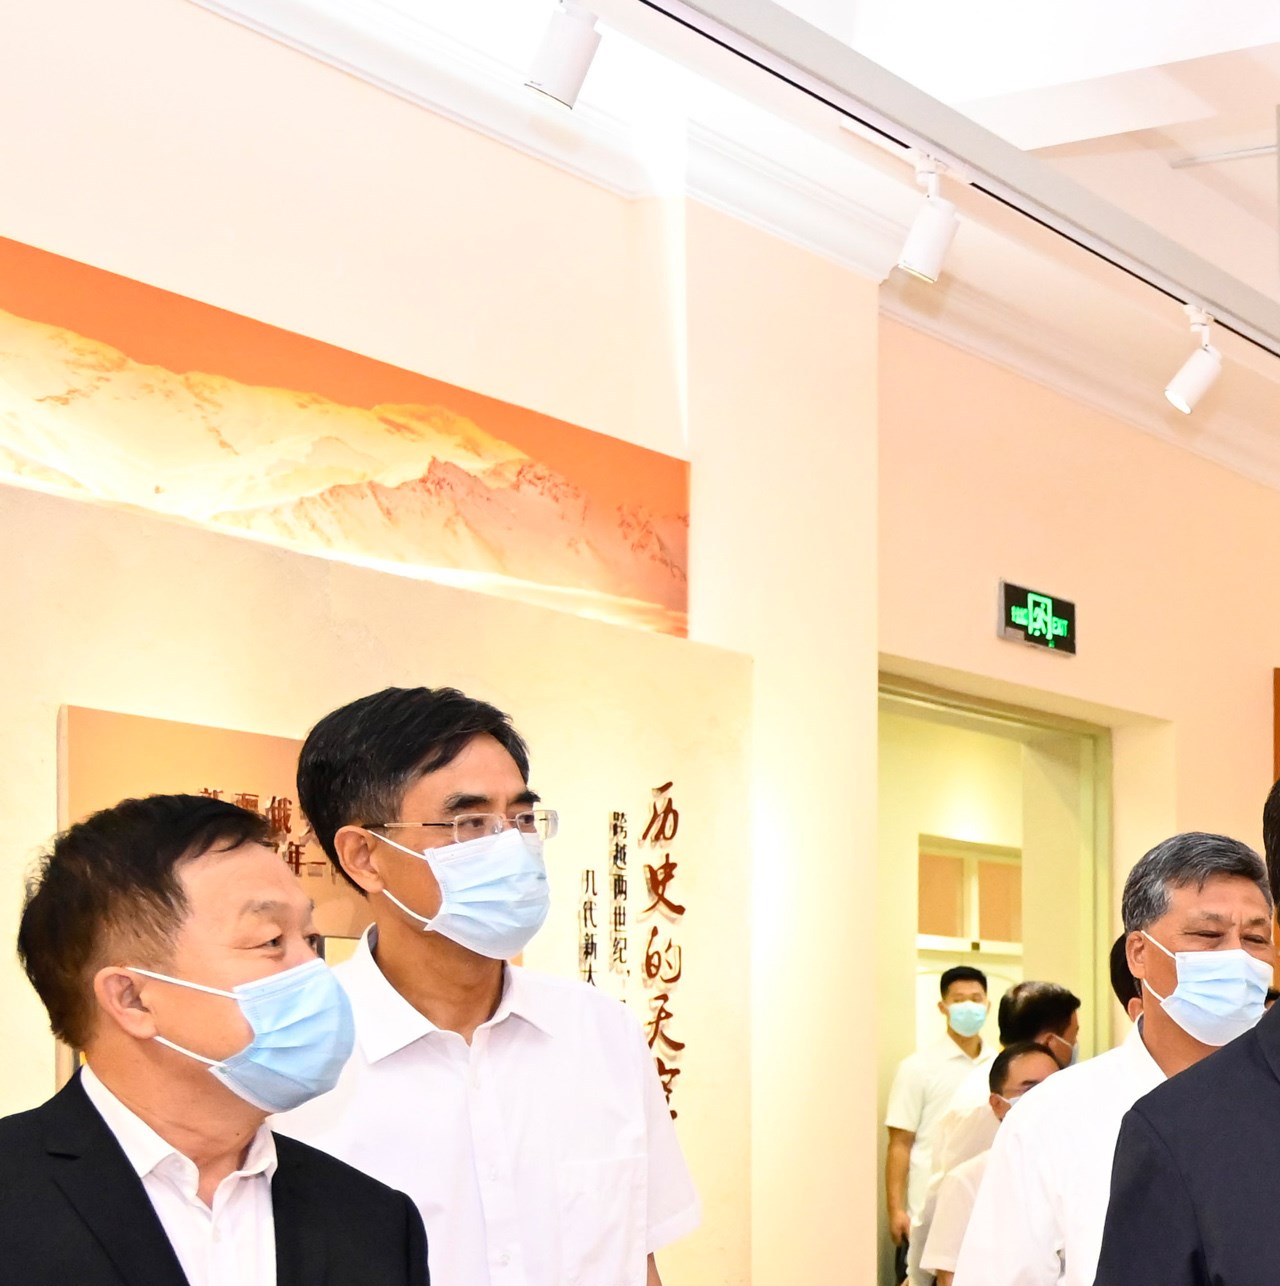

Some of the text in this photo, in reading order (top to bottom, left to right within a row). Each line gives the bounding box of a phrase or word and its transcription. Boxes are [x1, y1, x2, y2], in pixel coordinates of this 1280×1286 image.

[612, 811, 630, 1004] 跨越两世纪，
